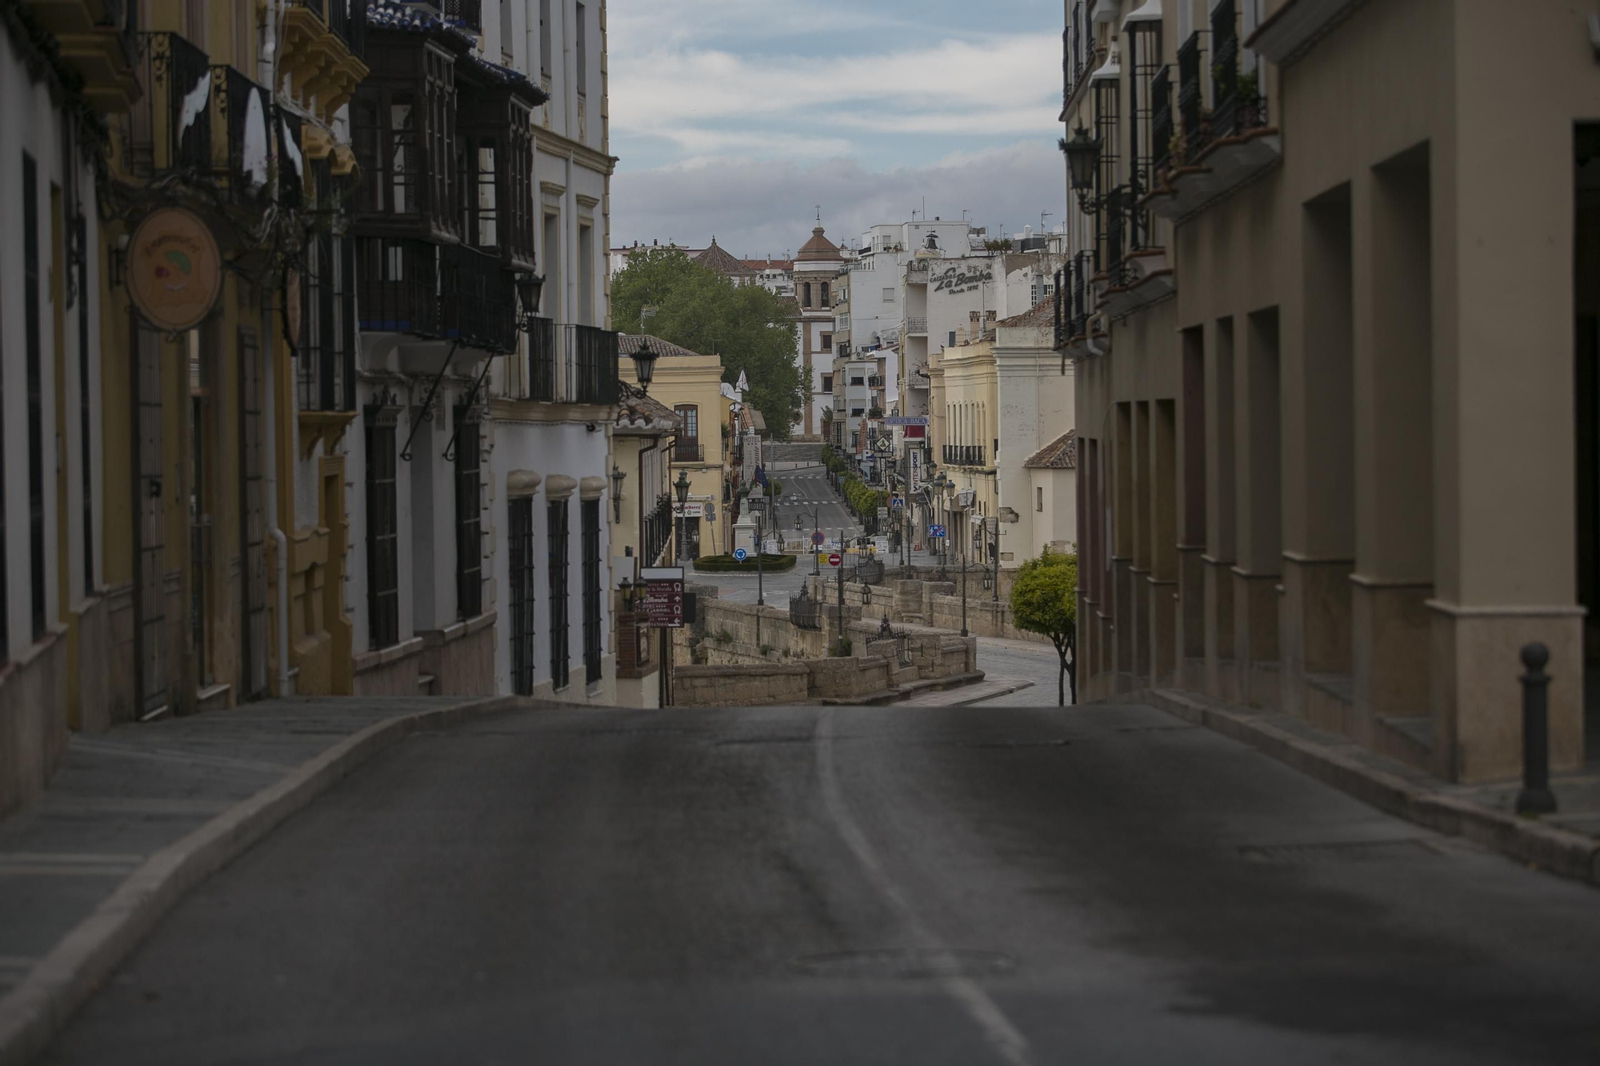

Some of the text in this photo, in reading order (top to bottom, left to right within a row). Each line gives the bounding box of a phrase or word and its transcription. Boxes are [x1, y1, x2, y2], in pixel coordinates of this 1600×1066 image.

[930, 273, 957, 283] CALZADOS
[934, 267, 992, 292] La Bomba
